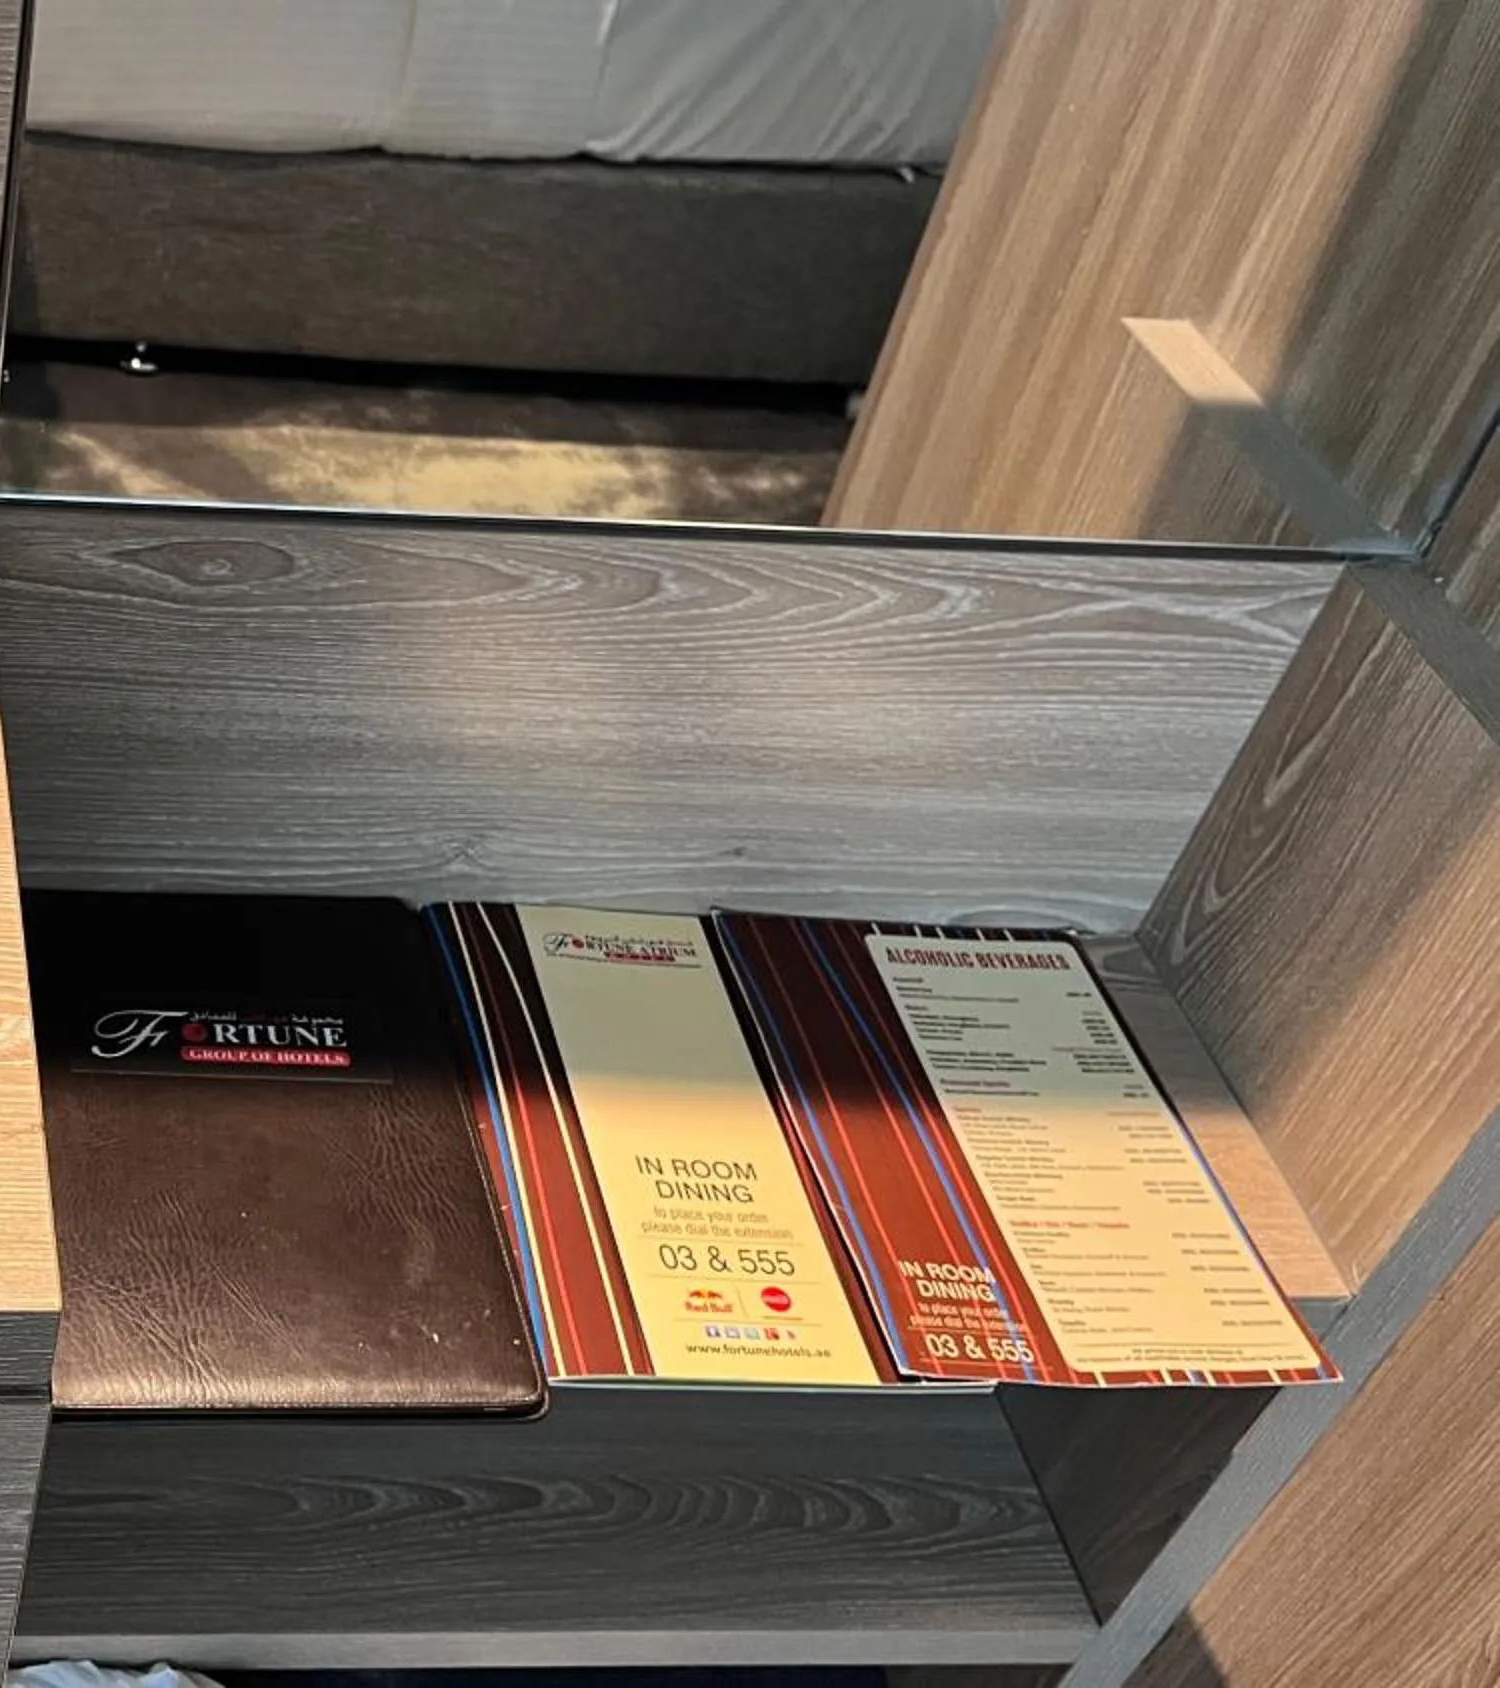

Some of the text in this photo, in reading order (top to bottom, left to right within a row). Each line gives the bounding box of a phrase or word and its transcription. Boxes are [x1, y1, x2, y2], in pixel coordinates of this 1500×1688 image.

[886, 947, 1072, 970] ALCOHOLIC BEVERAGES
[90, 1009, 348, 1059] FORTUNE
[635, 1155, 758, 1181] IN ROOM
[655, 1180, 754, 1203] DINING
[659, 1244, 796, 1276] 03 & 555
[899, 1260, 997, 1284] IN ROOM
[915, 1279, 996, 1303] DINING
[925, 1333, 1035, 1363] 03 & 555
